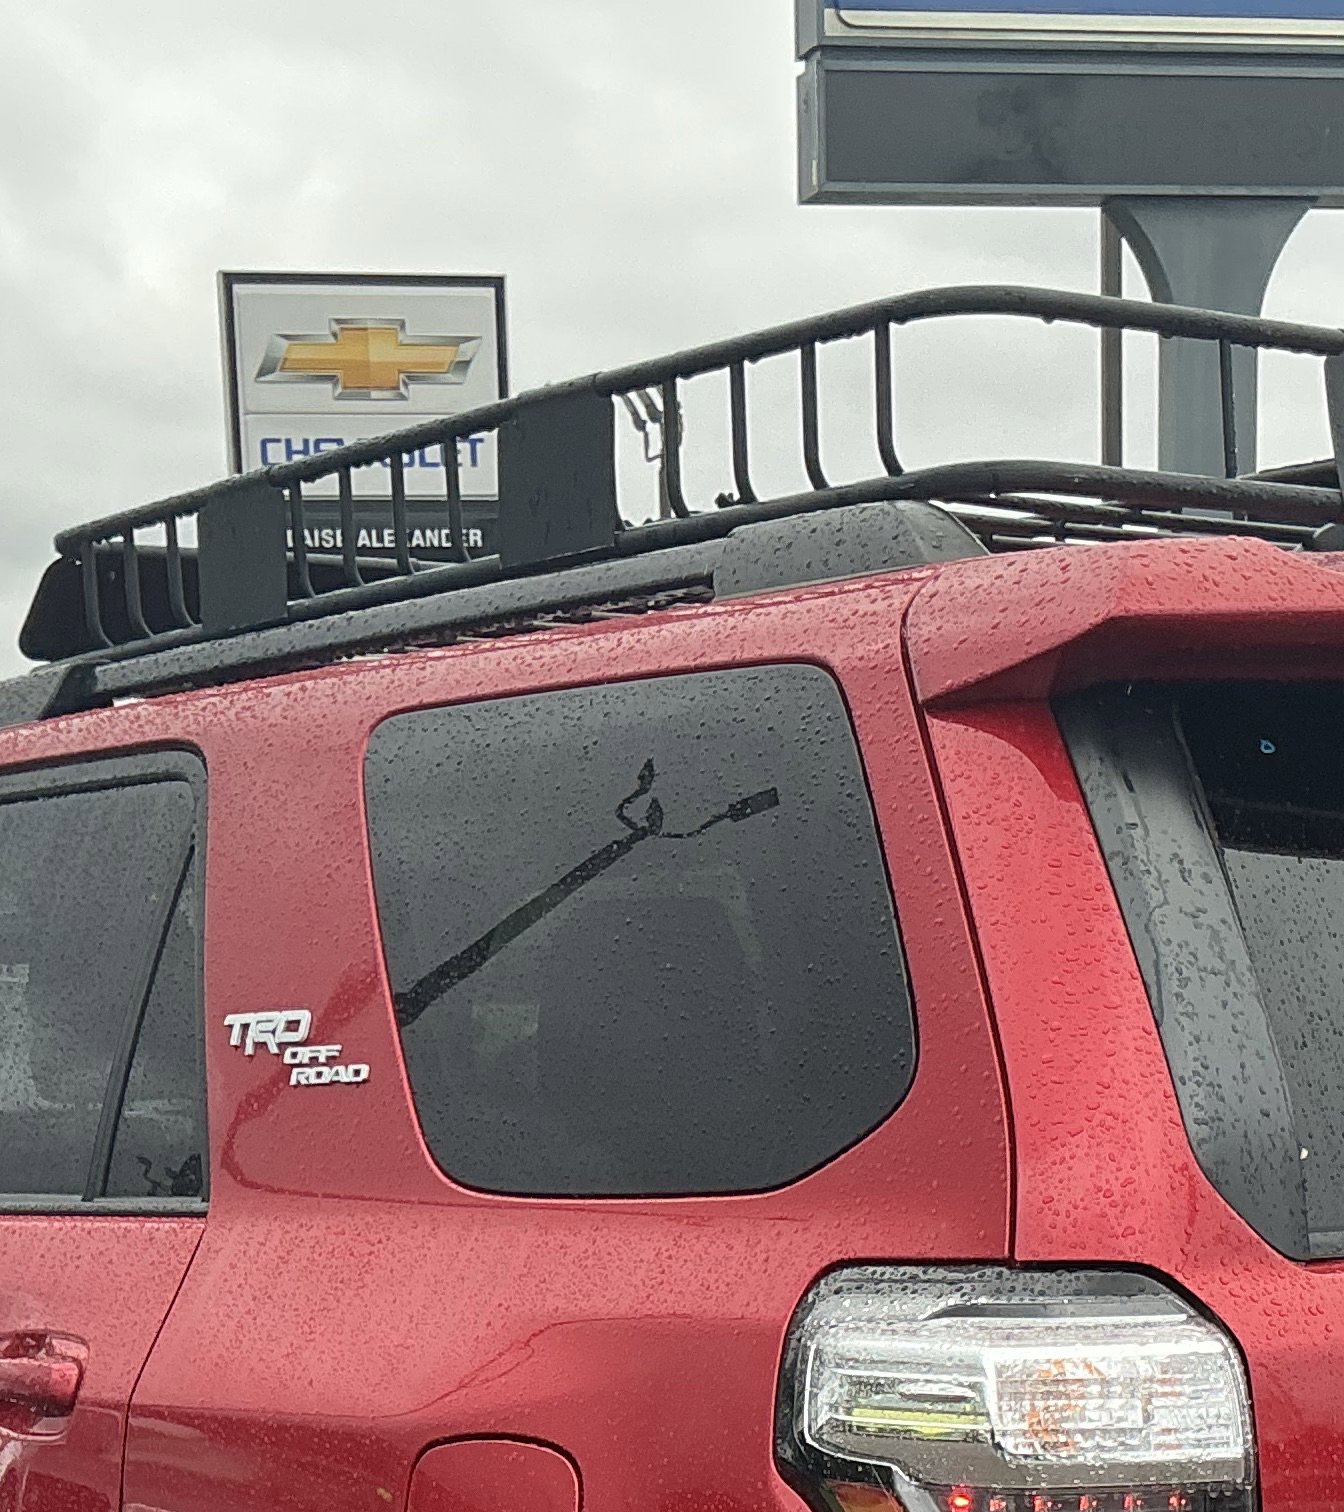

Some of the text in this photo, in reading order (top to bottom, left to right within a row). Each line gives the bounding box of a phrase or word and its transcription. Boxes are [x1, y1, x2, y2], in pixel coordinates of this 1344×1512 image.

[260, 437, 485, 467] CHELT
[357, 528, 483, 548] ALEANDER
[223, 1008, 312, 1057] TRD
[282, 1043, 343, 1065] OFF
[289, 1063, 370, 1086] ROAD
